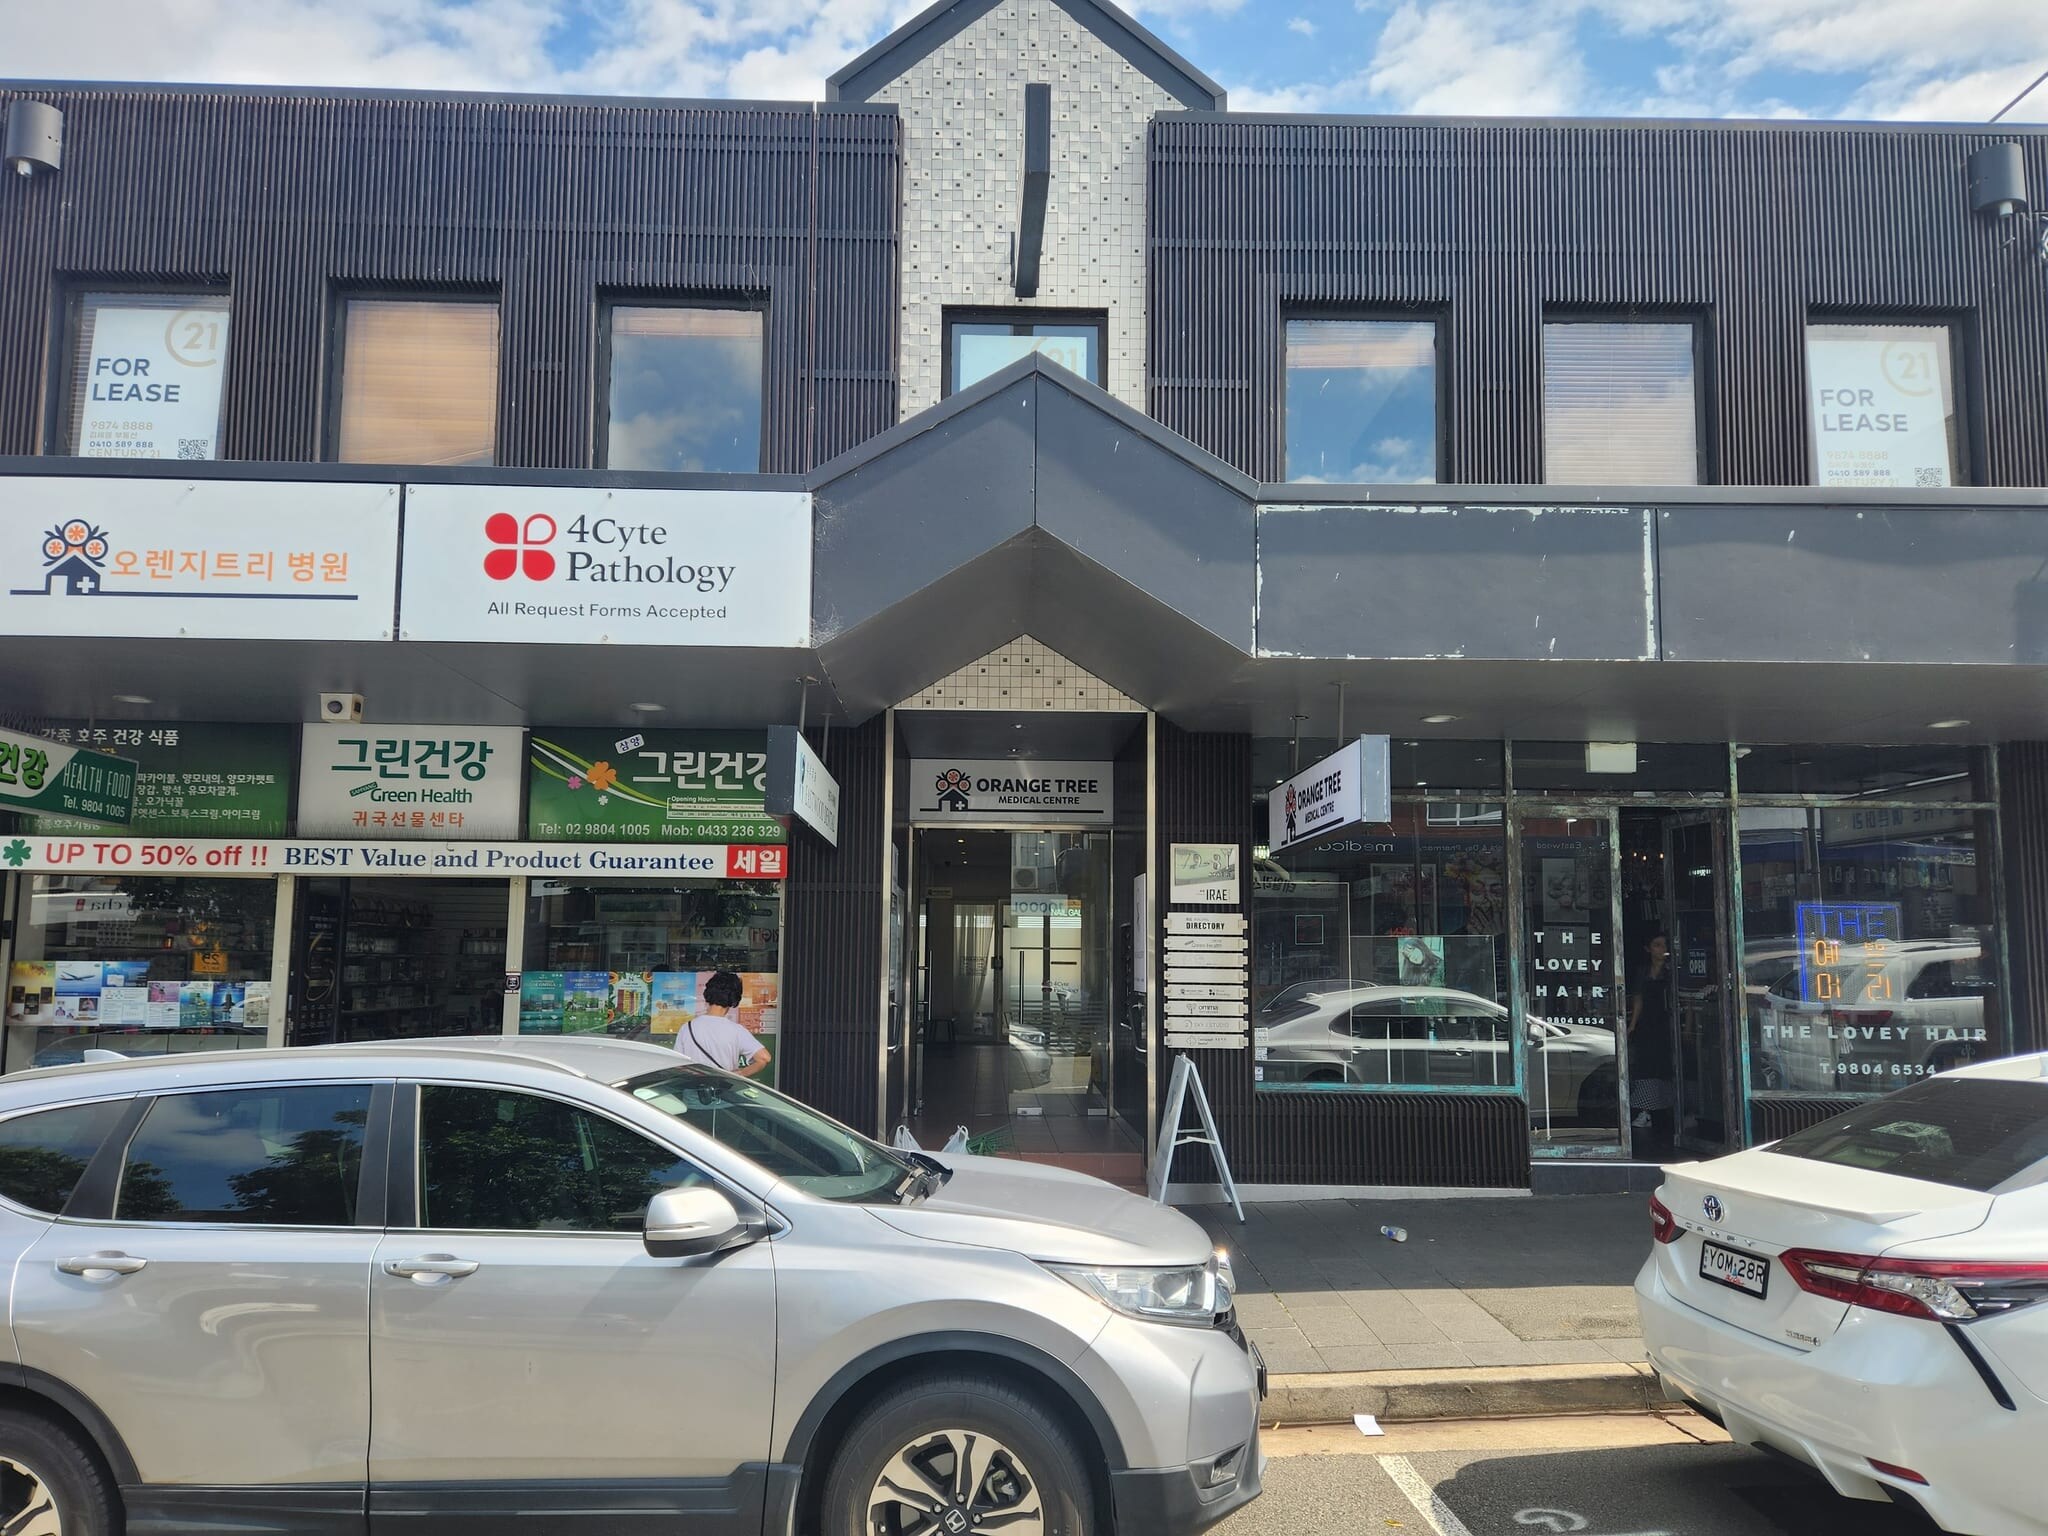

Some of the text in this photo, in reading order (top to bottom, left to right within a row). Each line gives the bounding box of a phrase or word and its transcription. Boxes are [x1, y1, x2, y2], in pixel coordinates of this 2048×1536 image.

[183, 322, 219, 350] 21
[95, 358, 150, 377] FOR
[1897, 352, 1931, 380] 21
[92, 383, 181, 403] LEASE
[1820, 389, 1875, 407] FOR
[90, 421, 154, 431] 9874 8888
[1822, 413, 1909, 432] LEASE
[88, 448, 148, 458] CENTURY
[89, 440, 154, 449] 0410 589 888
[1828, 469, 1891, 477] 0410 589 888
[566, 513, 668, 552] 4Cyte
[110, 549, 349, 583] 오렌지트리 병원
[565, 551, 736, 593] Pathology
[487, 601, 727, 621] All Request Forms Accepted
[76, 728, 108, 745] 호주
[113, 729, 144, 746] 건강
[149, 730, 180, 746] 식품
[618, 736, 642, 752] 삼양
[332, 739, 494, 782] 그린건강
[62, 760, 131, 799] HEALTH FOOD
[976, 778, 1099, 793] ORANGE TREE
[371, 788, 473, 804] Green Health
[671, 795, 697, 803] Opening
[1297, 770, 1342, 811] ORANGE TREE
[63, 795, 126, 818] Tel. 9804 1005
[998, 796, 1080, 805] MEDICAL CENTRE
[352, 811, 465, 828] 귀국선물센타
[1305, 801, 1335, 824] MEDICAL CENTRE
[538, 823, 781, 838] Tel: 02 9804 1005 Mob: 0433 236 329
[45, 843, 85, 864] UP
[93, 844, 132, 865] TO
[141, 845, 197, 866] 50%
[205, 845, 242, 866] off
[284, 847, 714, 872] BEST Value and Product Guarantee
[733, 850, 782, 874] 세일
[1206, 889, 1228, 901] IRAE
[1186, 922, 1225, 930] DIRECTORY
[1814, 911, 1886, 938] THE
[1533, 932, 1602, 945] THE
[1535, 959, 1602, 971] LOVEY
[1536, 985, 1604, 998] HAIR
[1577, 1016, 1605, 1025] 6534
[1763, 1025, 1988, 1042] THE LOVEY HAIR
[1819, 1062, 1937, 1076] T.9804 6534
